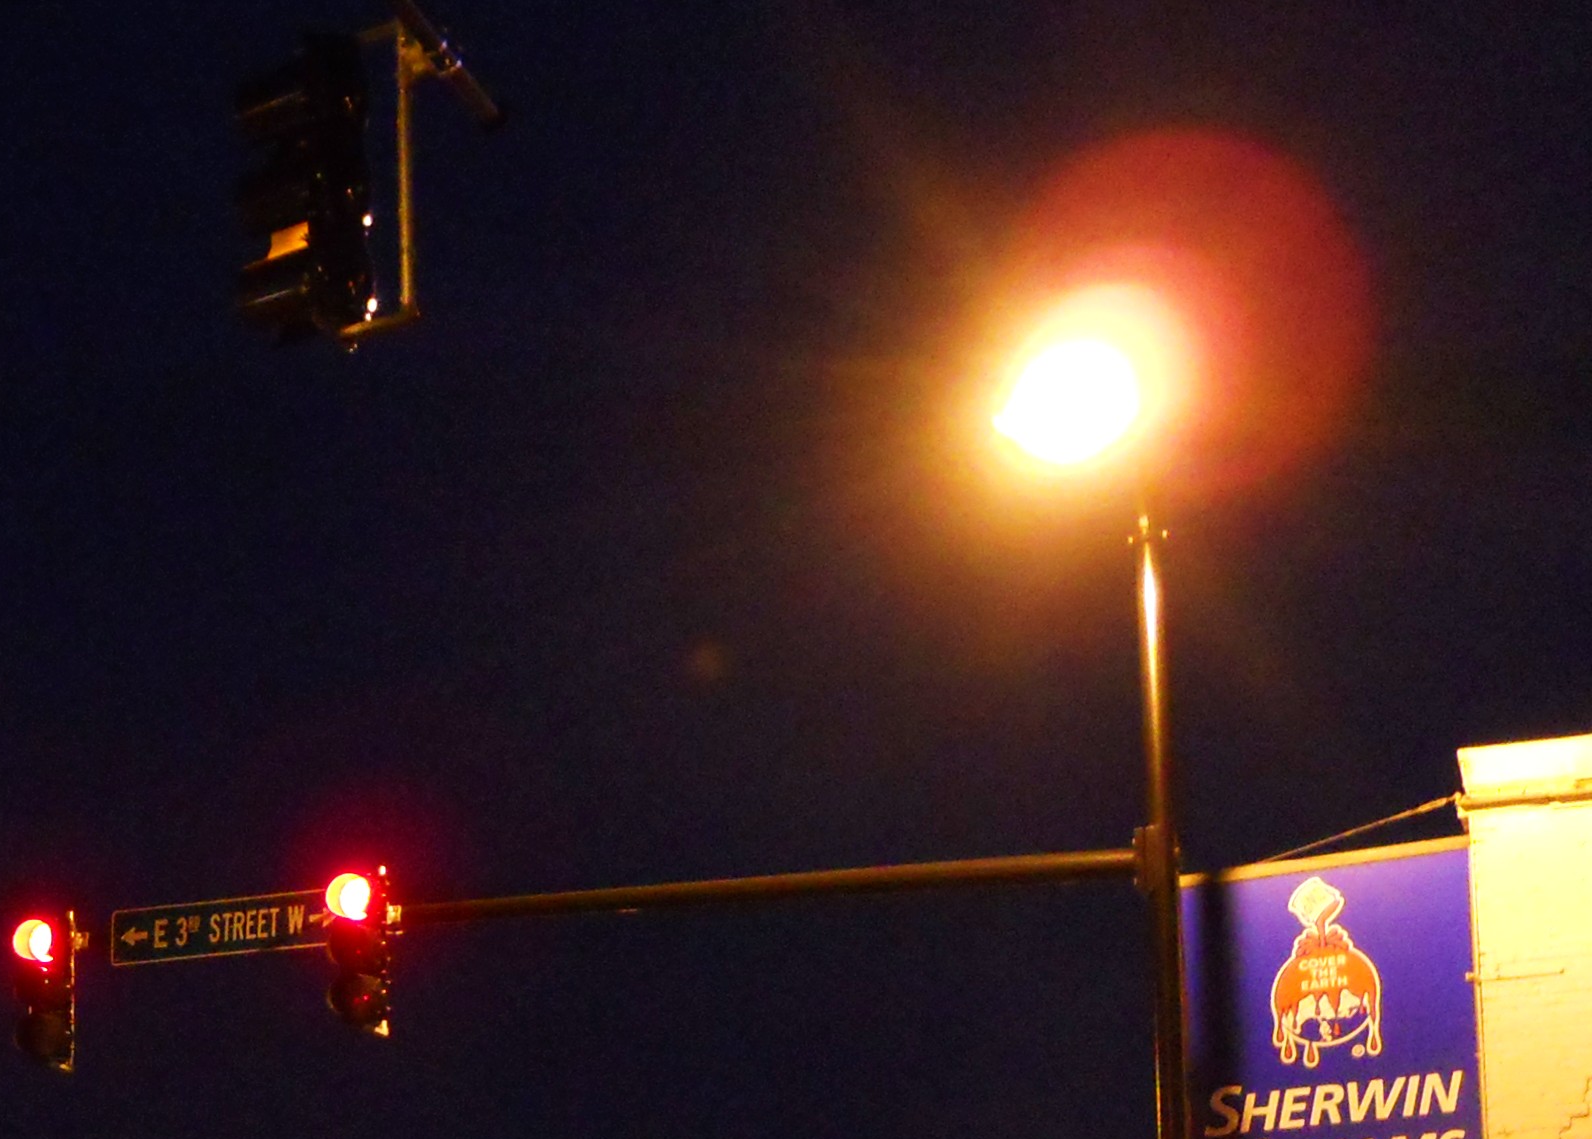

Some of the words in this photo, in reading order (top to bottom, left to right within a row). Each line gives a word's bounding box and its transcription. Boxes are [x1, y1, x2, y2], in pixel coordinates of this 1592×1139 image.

[153, 917, 169, 949] E
[208, 907, 281, 944] STREET
[287, 904, 306, 935] W
[1298, 953, 1347, 972] COVER
[1310, 965, 1338, 981] THE
[1300, 975, 1348, 991] EARTH
[1204, 1070, 1464, 1137] SHERWIN
